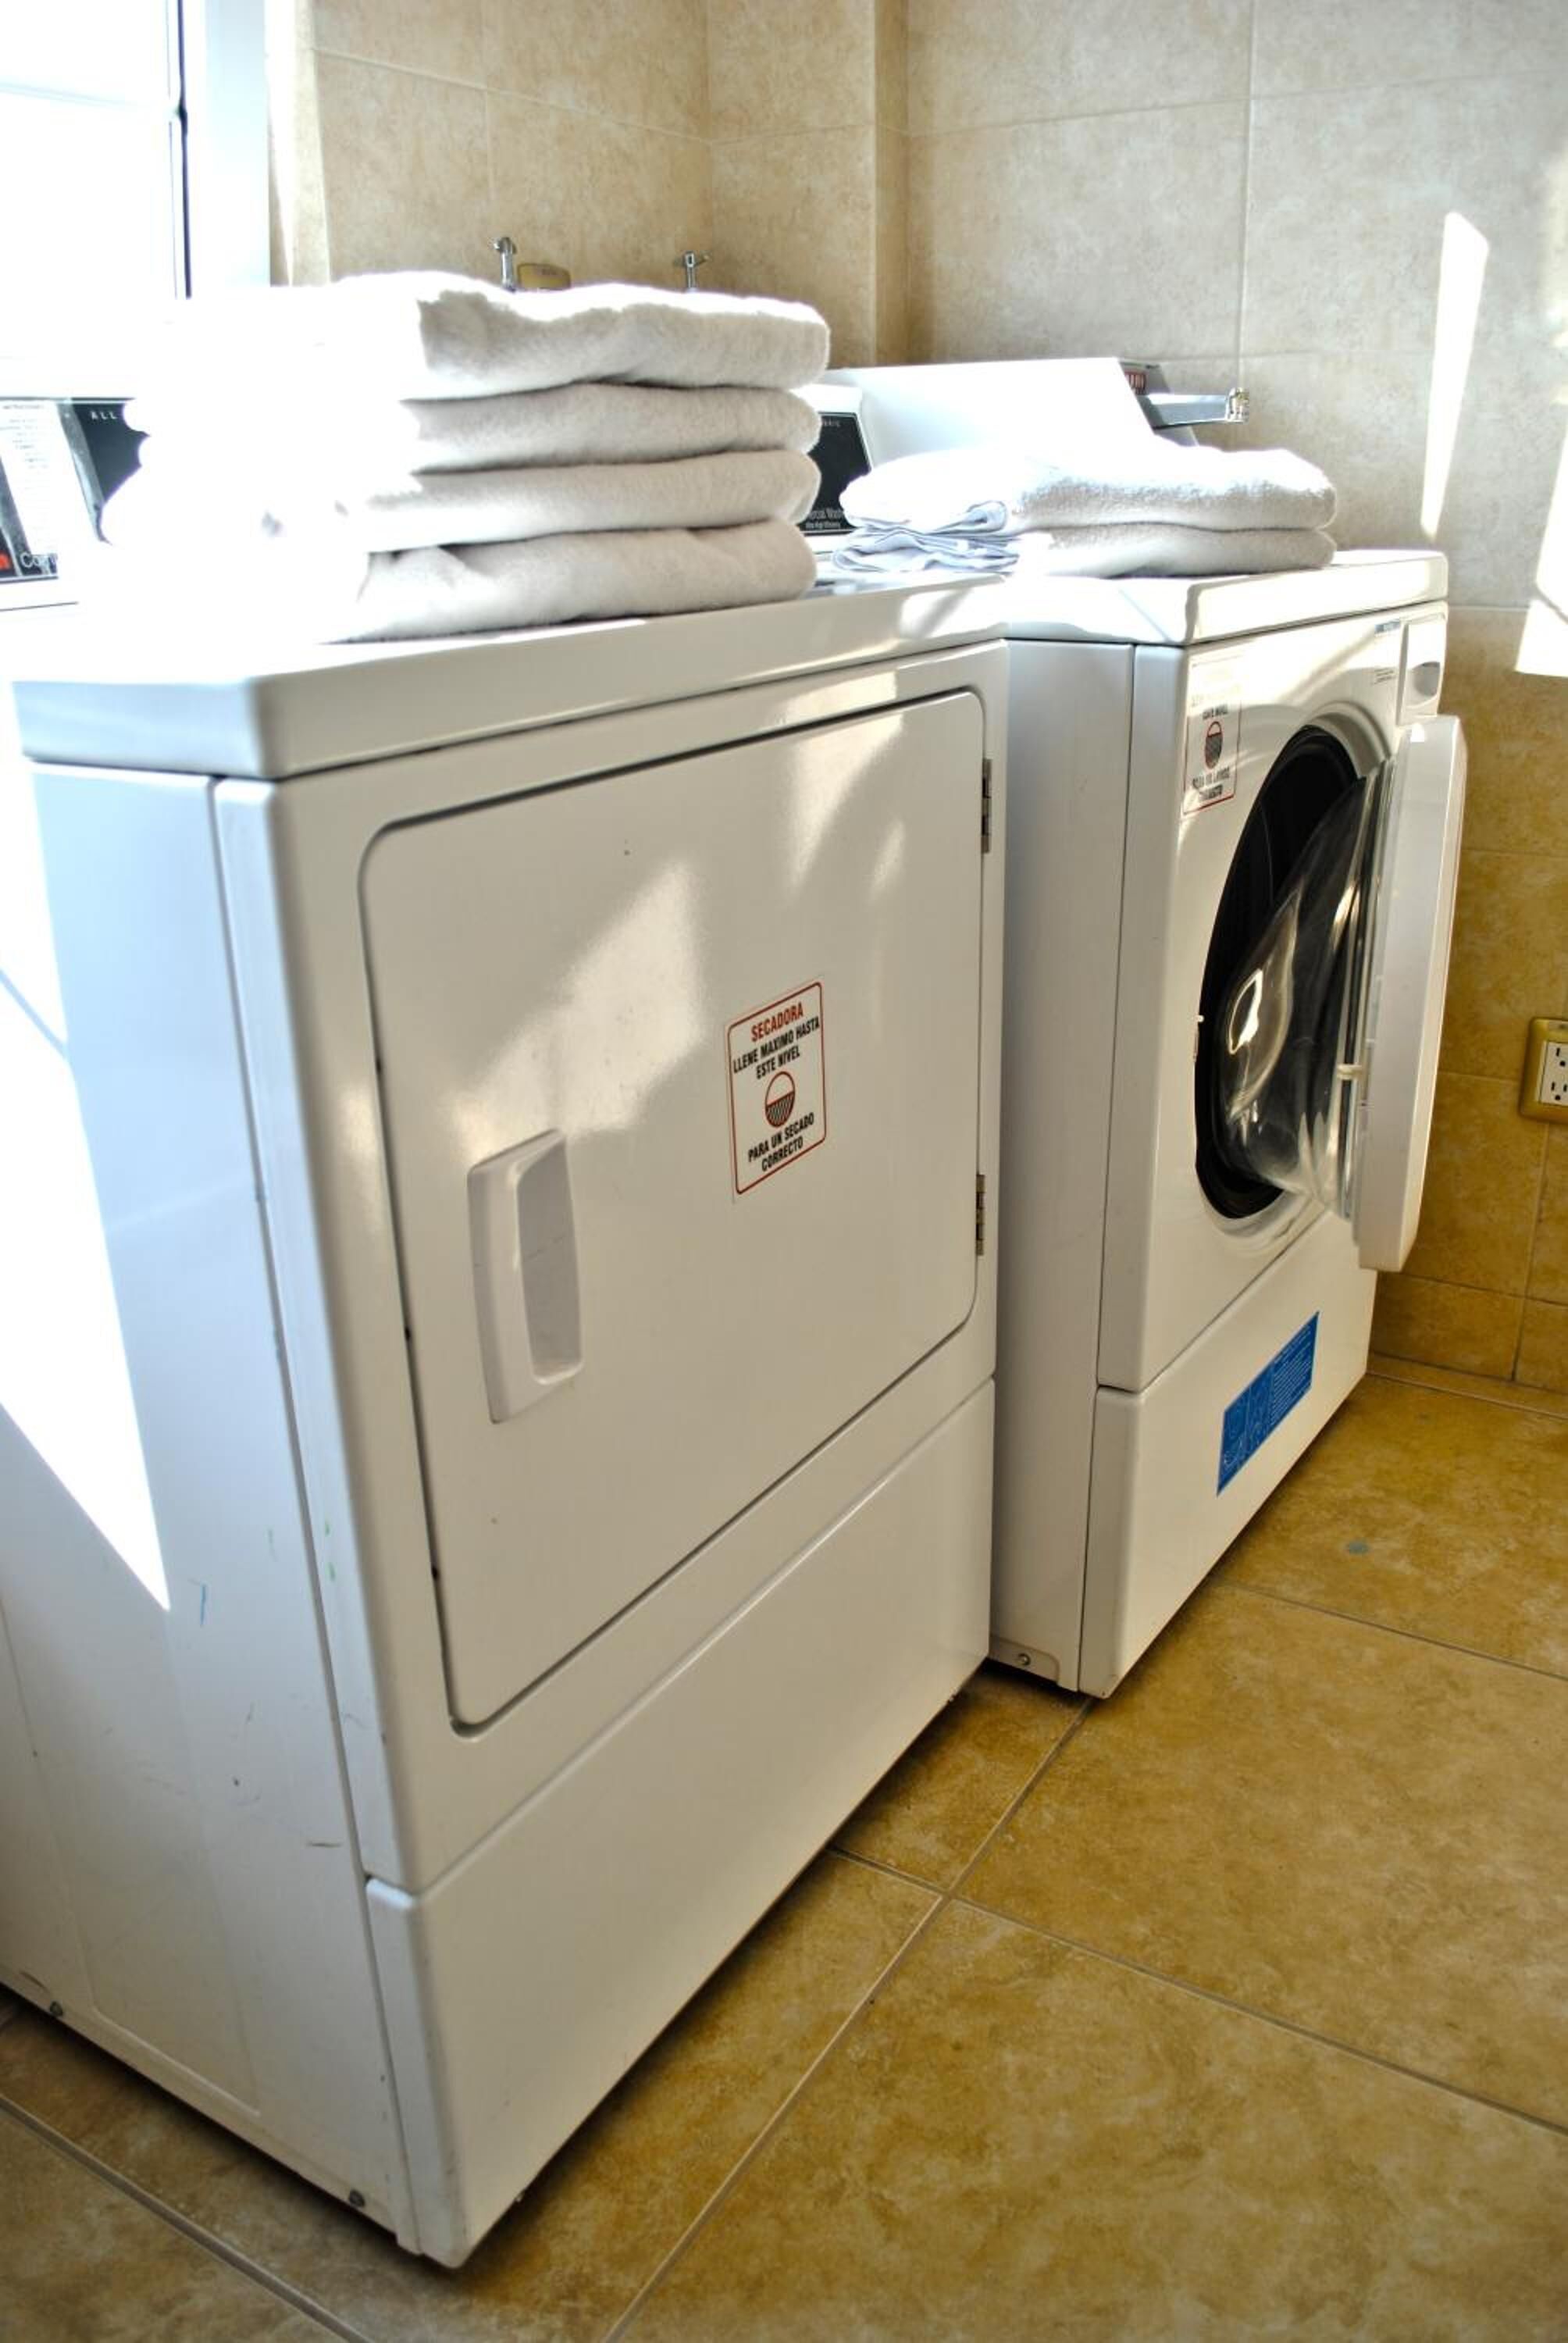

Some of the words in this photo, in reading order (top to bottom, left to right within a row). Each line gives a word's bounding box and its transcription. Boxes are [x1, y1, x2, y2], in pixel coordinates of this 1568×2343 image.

[751, 1002, 804, 1042] SECADORA
[733, 1047, 759, 1074] LLENE
[761, 1030, 794, 1057] MAXIMO
[796, 1016, 820, 1040] HASTA
[756, 1059, 776, 1079] ESTE
[779, 1046, 800, 1068] NIVEL
[748, 1142, 769, 1163] PARA
[771, 1131, 782, 1150] UN
[784, 1112, 814, 1140] SECADO
[761, 1136, 804, 1172] CORRECTO
